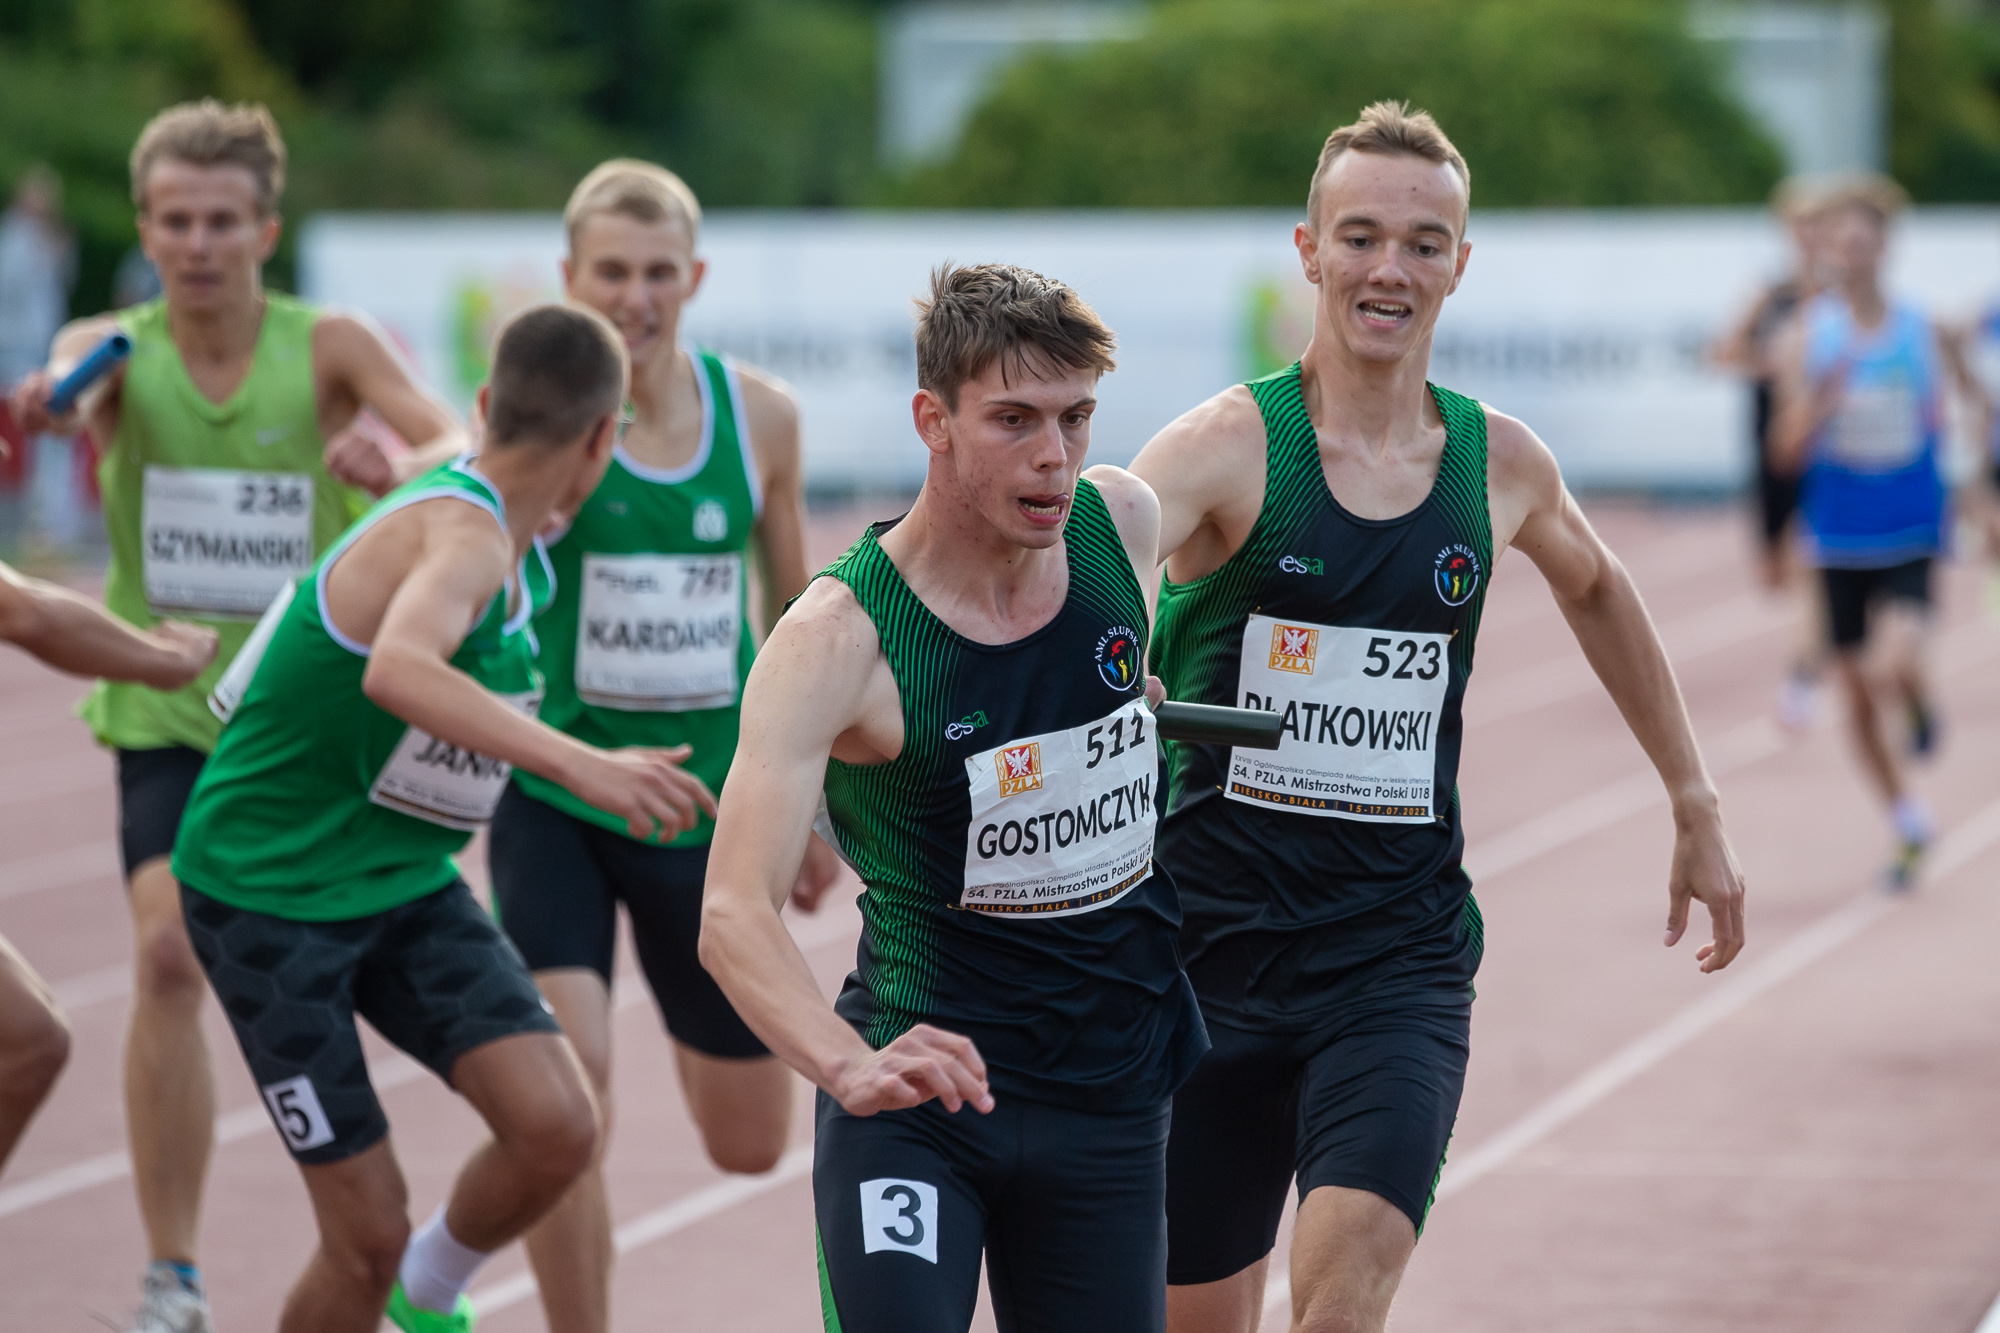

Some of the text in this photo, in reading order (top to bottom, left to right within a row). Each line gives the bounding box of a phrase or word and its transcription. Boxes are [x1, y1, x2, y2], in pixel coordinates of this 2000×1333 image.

[1279, 555, 1324, 576] esa
[1094, 636, 1109, 662] AML
[1271, 655, 1311, 673] PZLA
[1362, 637, 1441, 681] 523
[944, 710, 990, 741] esa
[1085, 707, 1146, 770] 511
[1002, 775, 1041, 796] PZLA
[1232, 764, 1430, 799] 54. PZLA Mistrzostwa Polski U18
[1253, 760, 1304, 775] Ogólnopolska
[1305, 768, 1344, 779] Olimpiada
[1345, 773, 1381, 784] Młodzieży
[976, 772, 1151, 860] GOSTOMCZYK
[1233, 784, 1426, 816] BIELSKO-BIAŁA 15-17.07.2022
[967, 888, 989, 899] 54.
[994, 888, 1028, 900] PZLA
[1032, 873, 1108, 899] Mistrzostwa
[1111, 855, 1139, 880] Polski
[1047, 870, 1084, 884] Olimpiada
[277, 1088, 310, 1141] 5
[881, 1184, 924, 1247] 3
